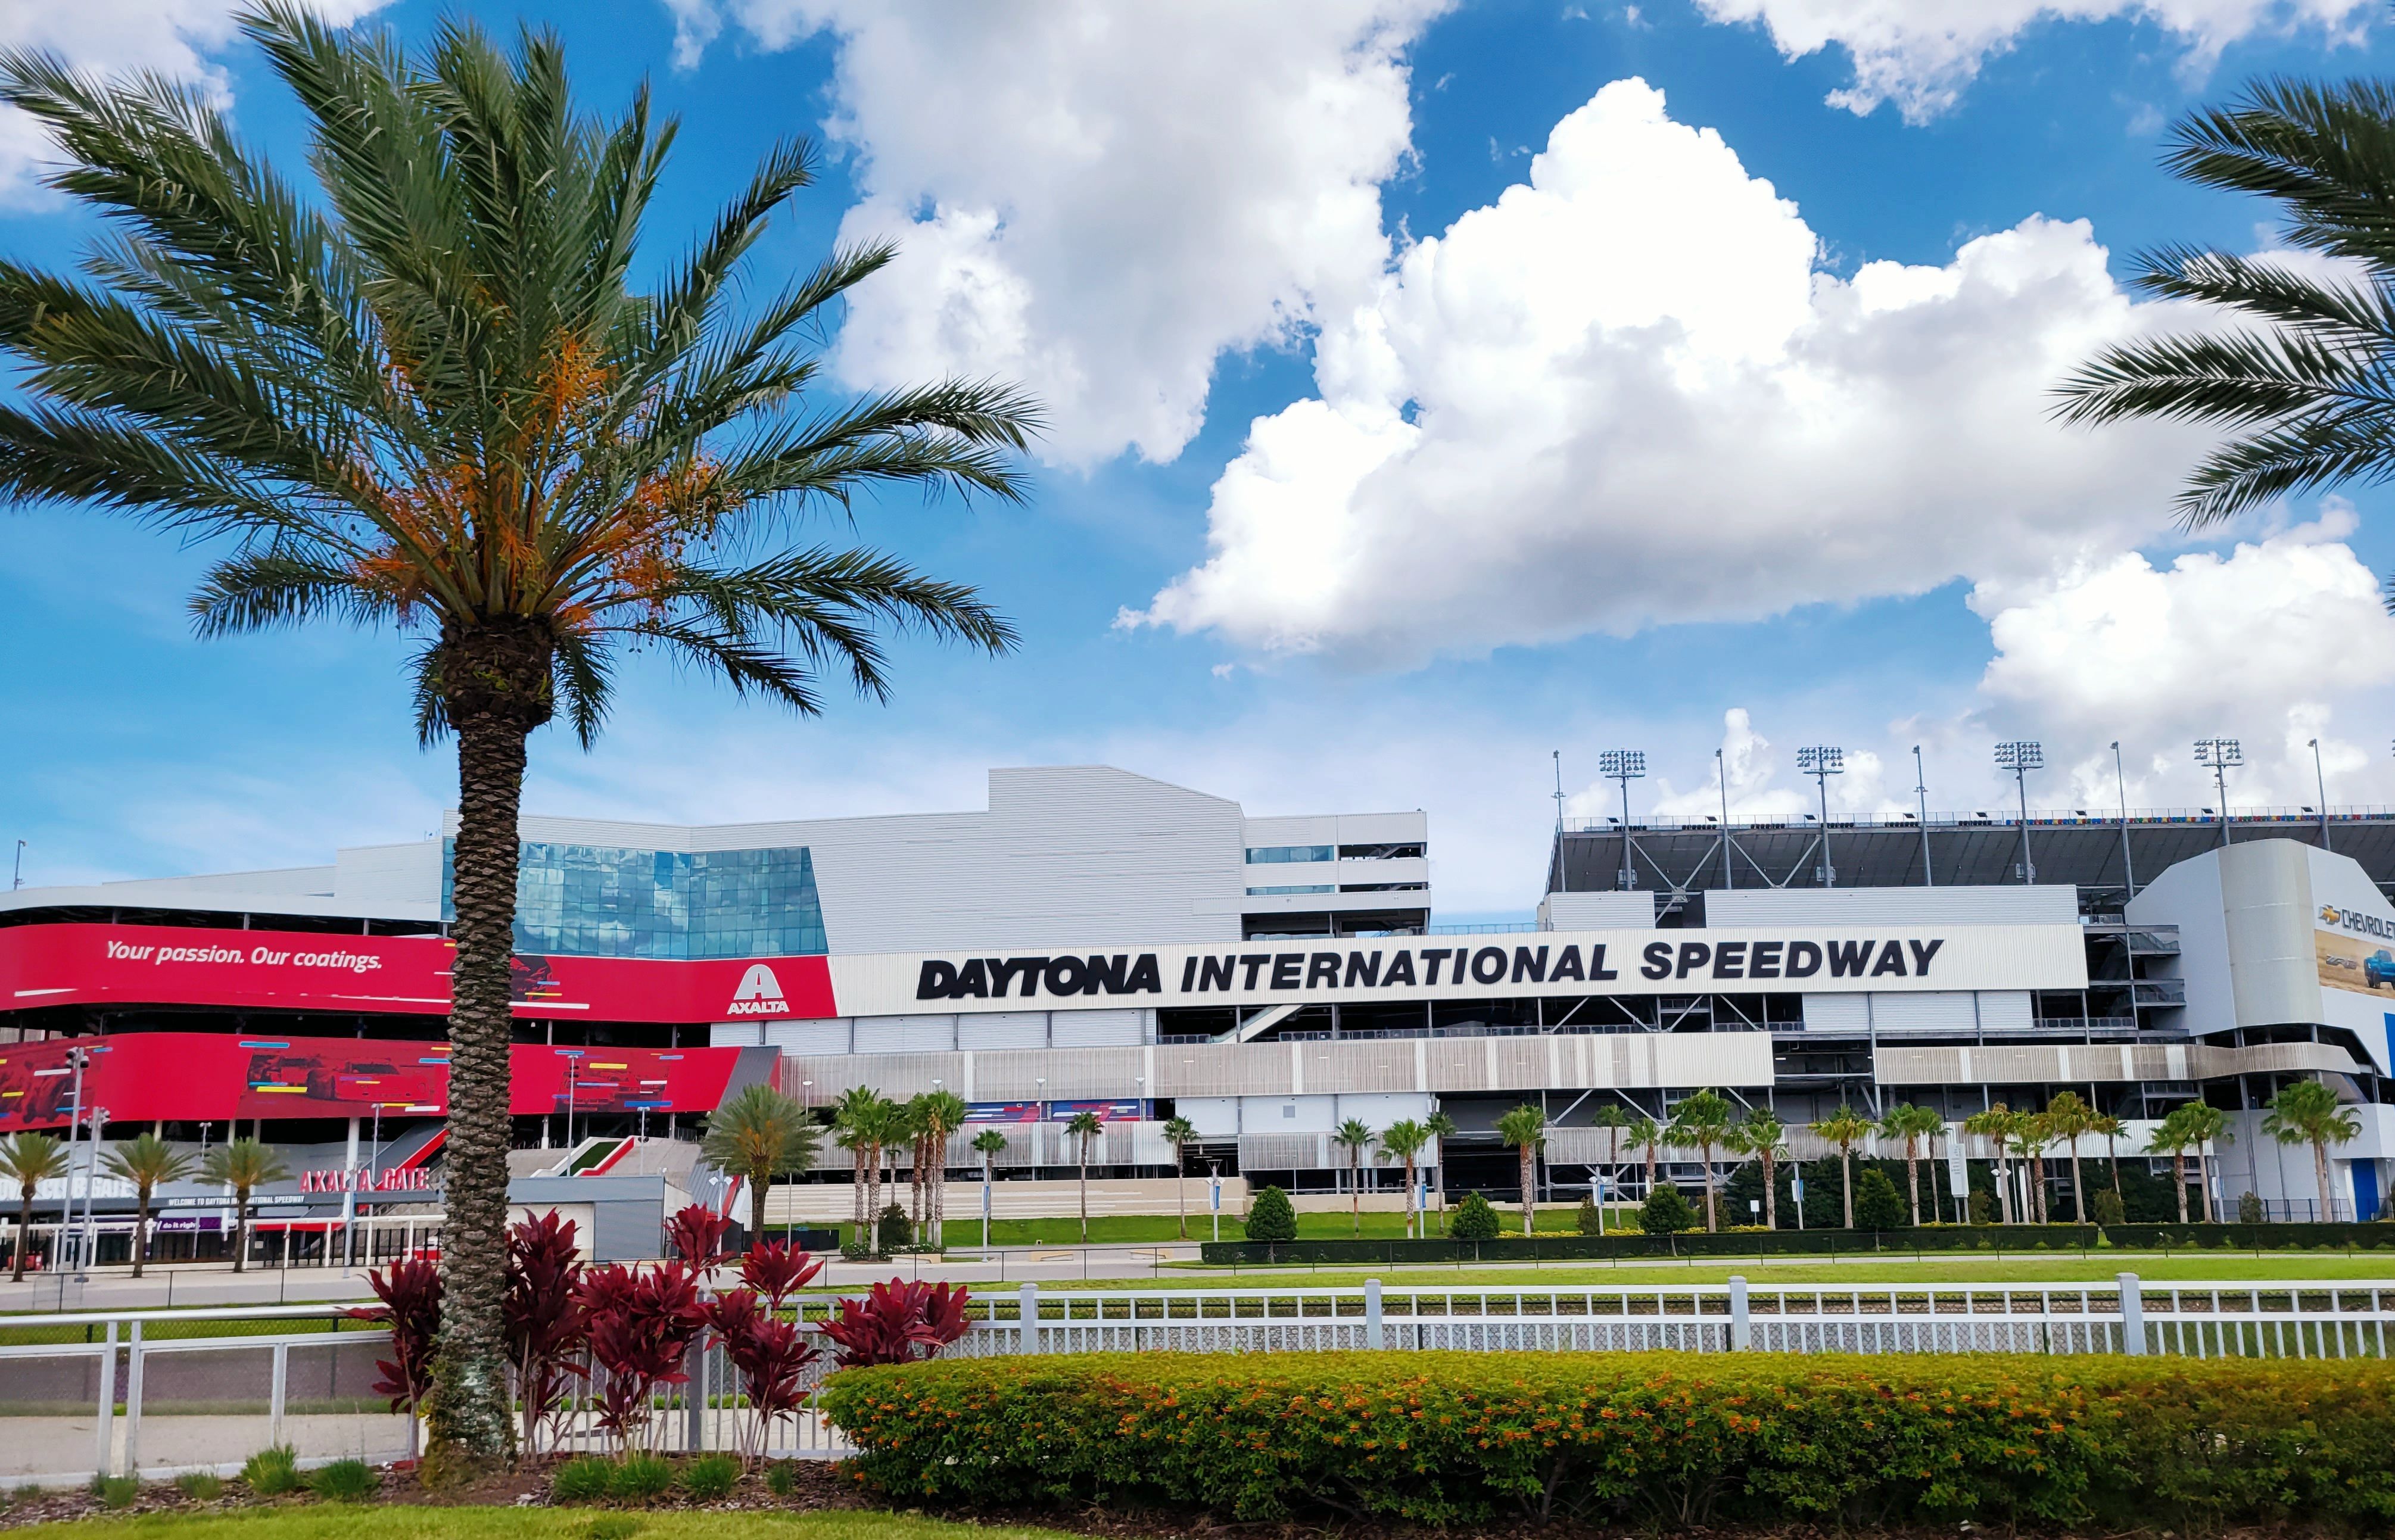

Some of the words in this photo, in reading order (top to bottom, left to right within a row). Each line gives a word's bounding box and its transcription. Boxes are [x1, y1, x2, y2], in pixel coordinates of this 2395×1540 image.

[107, 940, 154, 960] Your
[156, 945, 244, 965] passion.
[251, 946, 290, 965] Our
[294, 950, 382, 973] coatings.
[916, 953, 1161, 999] DAYTONA
[1181, 944, 1618, 992] INTERNATIONAL
[1640, 939, 1944, 980] SPEEDWAY
[727, 1000, 790, 1015] AXALTA
[382, 1167, 430, 1190] GATE
[205, 1197, 231, 1205] DAYTONA
[274, 1195, 305, 1204] SPEEDWAY
